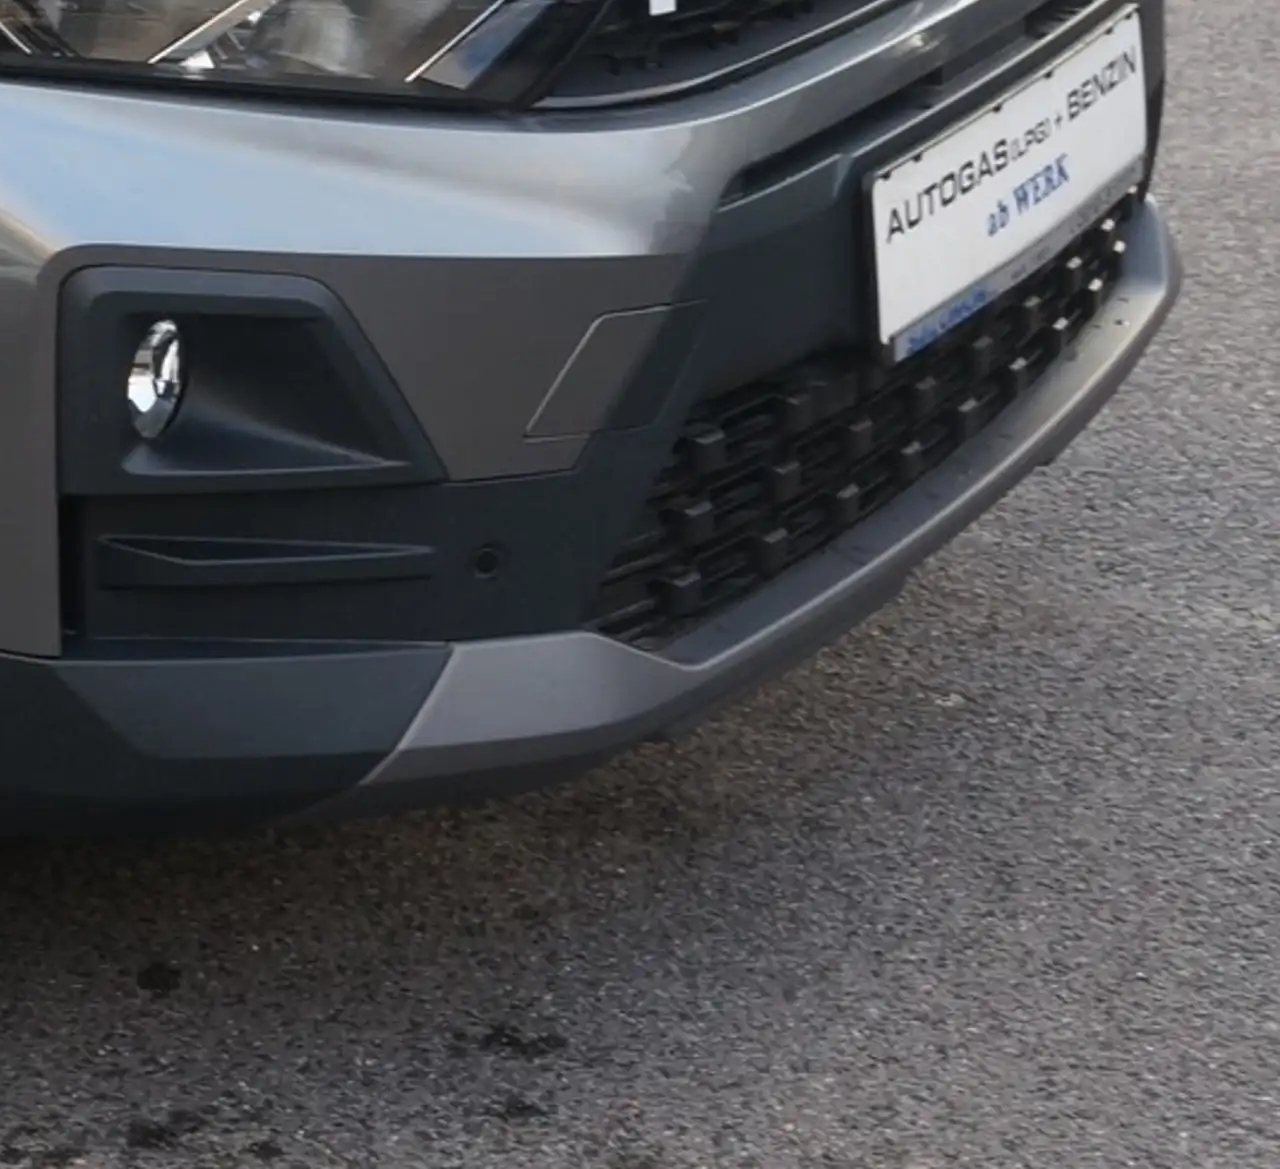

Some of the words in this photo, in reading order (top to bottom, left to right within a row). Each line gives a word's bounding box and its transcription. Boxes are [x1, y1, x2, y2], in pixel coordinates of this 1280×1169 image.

[886, 138, 1011, 244] AUTOGAS
[1067, 44, 1138, 122] BENZIN
[986, 201, 1011, 238] ab
[1013, 152, 1072, 215] WERK
